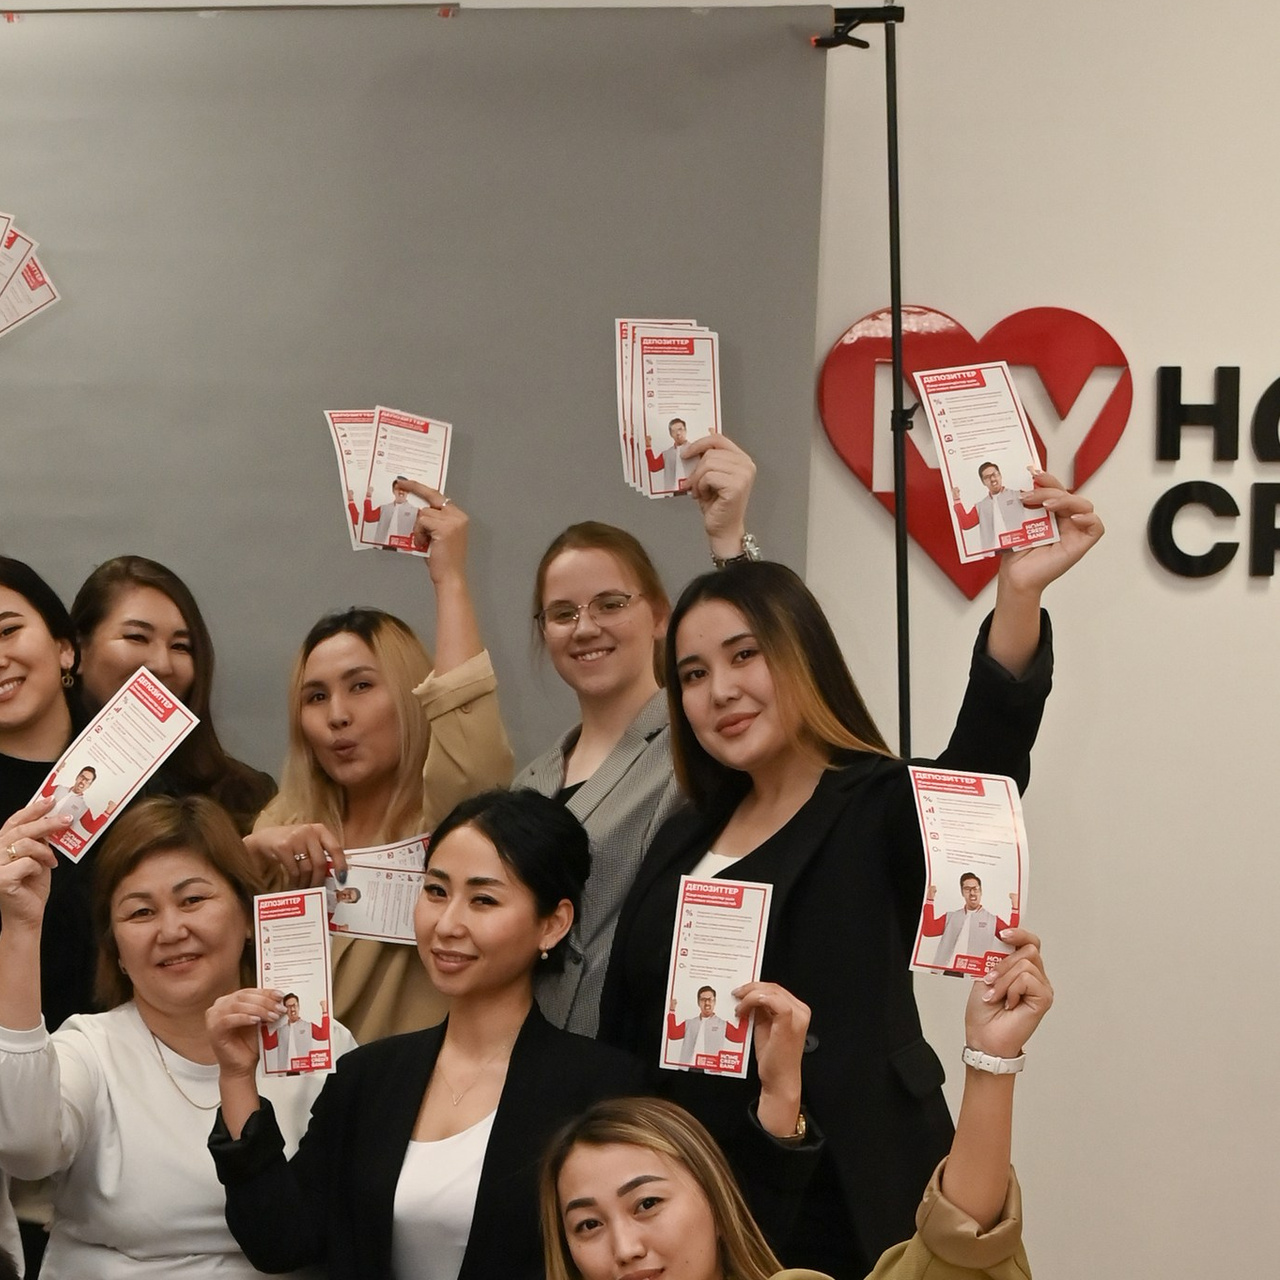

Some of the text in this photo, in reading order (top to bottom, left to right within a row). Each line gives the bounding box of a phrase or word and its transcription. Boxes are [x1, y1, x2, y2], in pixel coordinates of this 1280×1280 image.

[923, 371, 976, 383] ДЕПОЗИТТЕР
[136, 675, 174, 709] ДЕПОЗИТТЕР
[915, 772, 977, 785] ДЕПОЗИТТЕР
[686, 883, 739, 895] ДЕПОЗИТТЕР
[260, 897, 301, 909] ДЕПОЗИТТЕР
